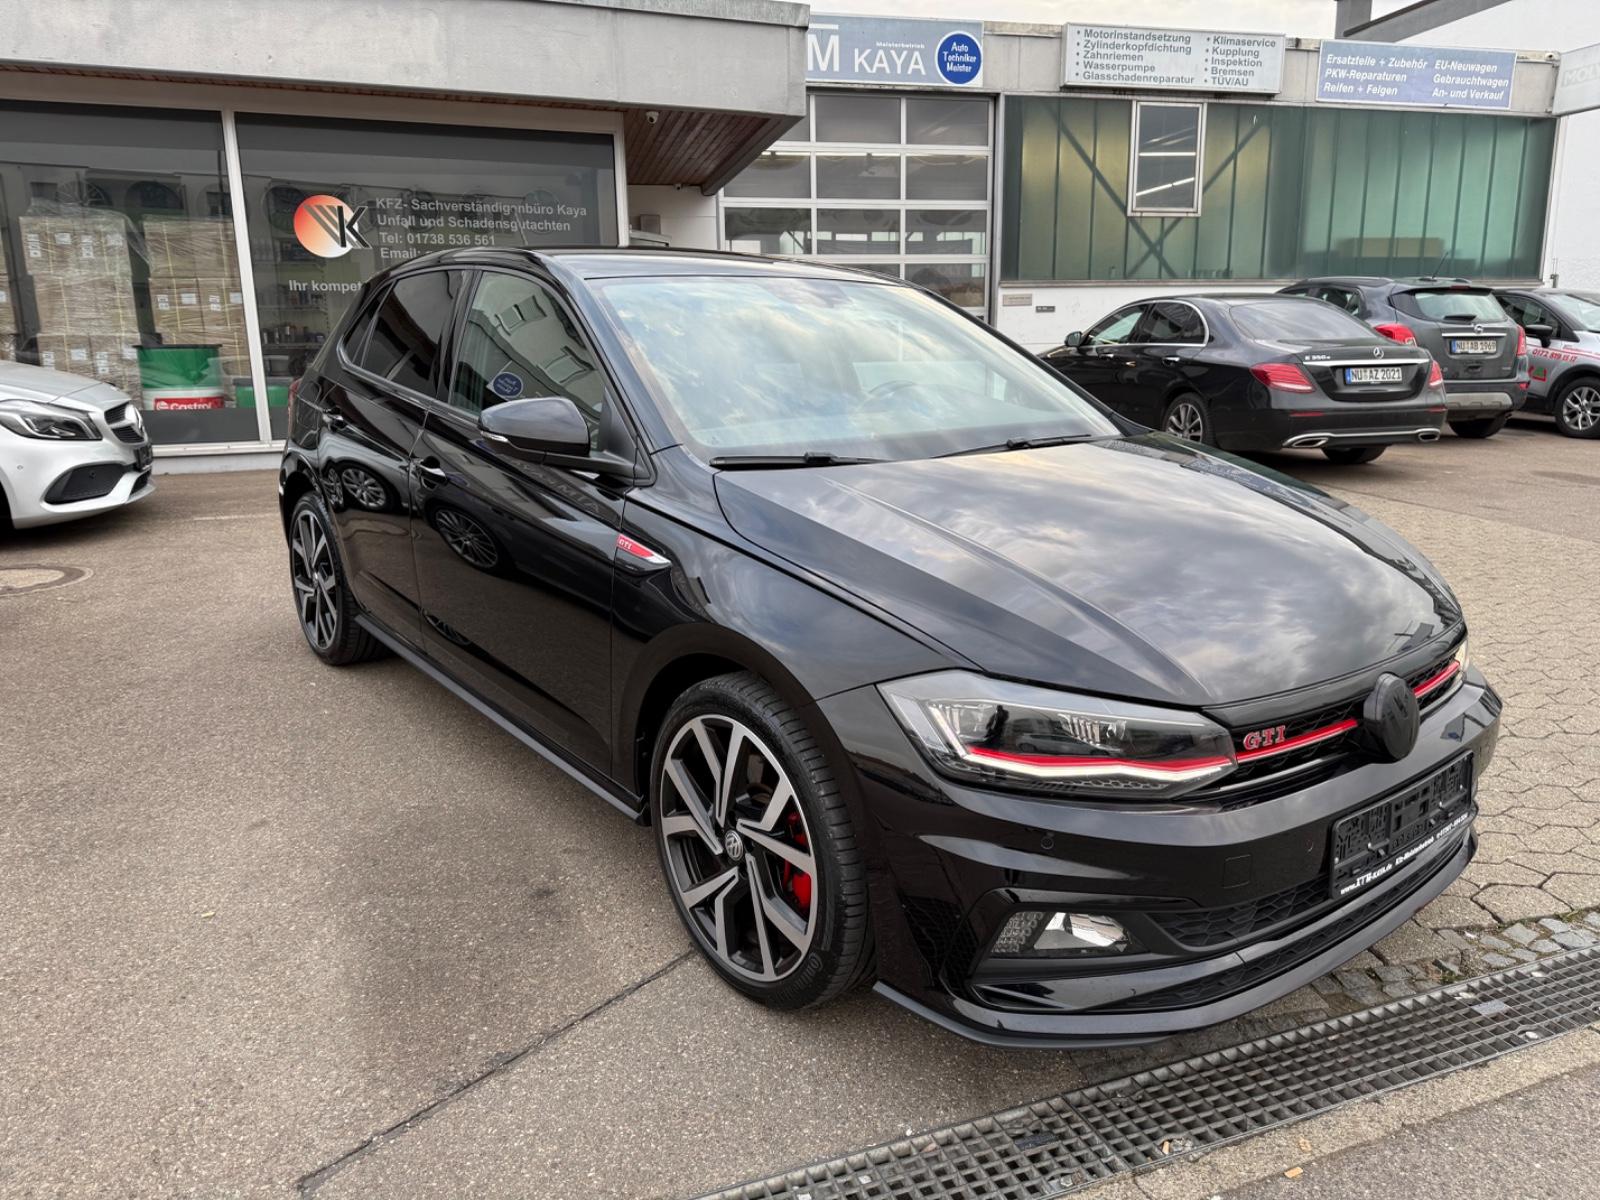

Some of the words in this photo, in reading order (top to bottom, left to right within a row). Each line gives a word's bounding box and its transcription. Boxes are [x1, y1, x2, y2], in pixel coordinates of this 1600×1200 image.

[1083, 29, 1191, 45] Motorinstandsetzung
[1212, 35, 1276, 48] Klimaservice
[951, 42, 968, 53] Auto
[1083, 40, 1192, 55] Zylinderkopfdichtung
[1212, 46, 1260, 59] Kupplung
[854, 48, 926, 76] KAYA
[943, 51, 977, 63] Techniker
[1083, 50, 1144, 62] Zahnriemen
[1211, 56, 1262, 67] Inspektion
[1326, 54, 1376, 66] Ersatzteile
[1388, 57, 1428, 69] Zubehör
[947, 62, 972, 73] Meister
[1083, 61, 1155, 73] Wasserpumpe
[1211, 66, 1254, 77] Bremsen
[1435, 59, 1498, 73] EU-Neuwagen
[1083, 71, 1195, 86] Glasschadenreparatur
[1211, 76, 1249, 86] TÜV/AU
[1325, 68, 1407, 82] PKW-Reparaturen
[1433, 74, 1509, 87] Gebrauchtwagen
[1324, 82, 1354, 93] Reifen
[1366, 84, 1398, 97] Felgen
[1432, 88, 1448, 98] An-
[1450, 89, 1467, 98] und
[1470, 89, 1504, 100] Verkauf
[376, 197, 408, 209] KFZ-
[411, 199, 553, 215] Sachverständigenbüro
[557, 204, 587, 218] Kaya
[377, 214, 416, 226] Unfall
[420, 215, 444, 227] und
[448, 217, 571, 232] Schadensgutachten
[380, 232, 402, 244] Tel:
[407, 232, 445, 245] 01738
[449, 234, 471, 245] 536
[474, 234, 496, 246] 561
[288, 279, 308, 291] Ihr
[311, 279, 362, 294] kompet
[1352, 369, 1363, 381] NU
[1369, 368, 1380, 380] AZ
[1381, 368, 1401, 380] 2021
[170, 402, 212, 410] Castrol
[618, 537, 633, 550] GTI
[1243, 725, 1286, 750] GTI
